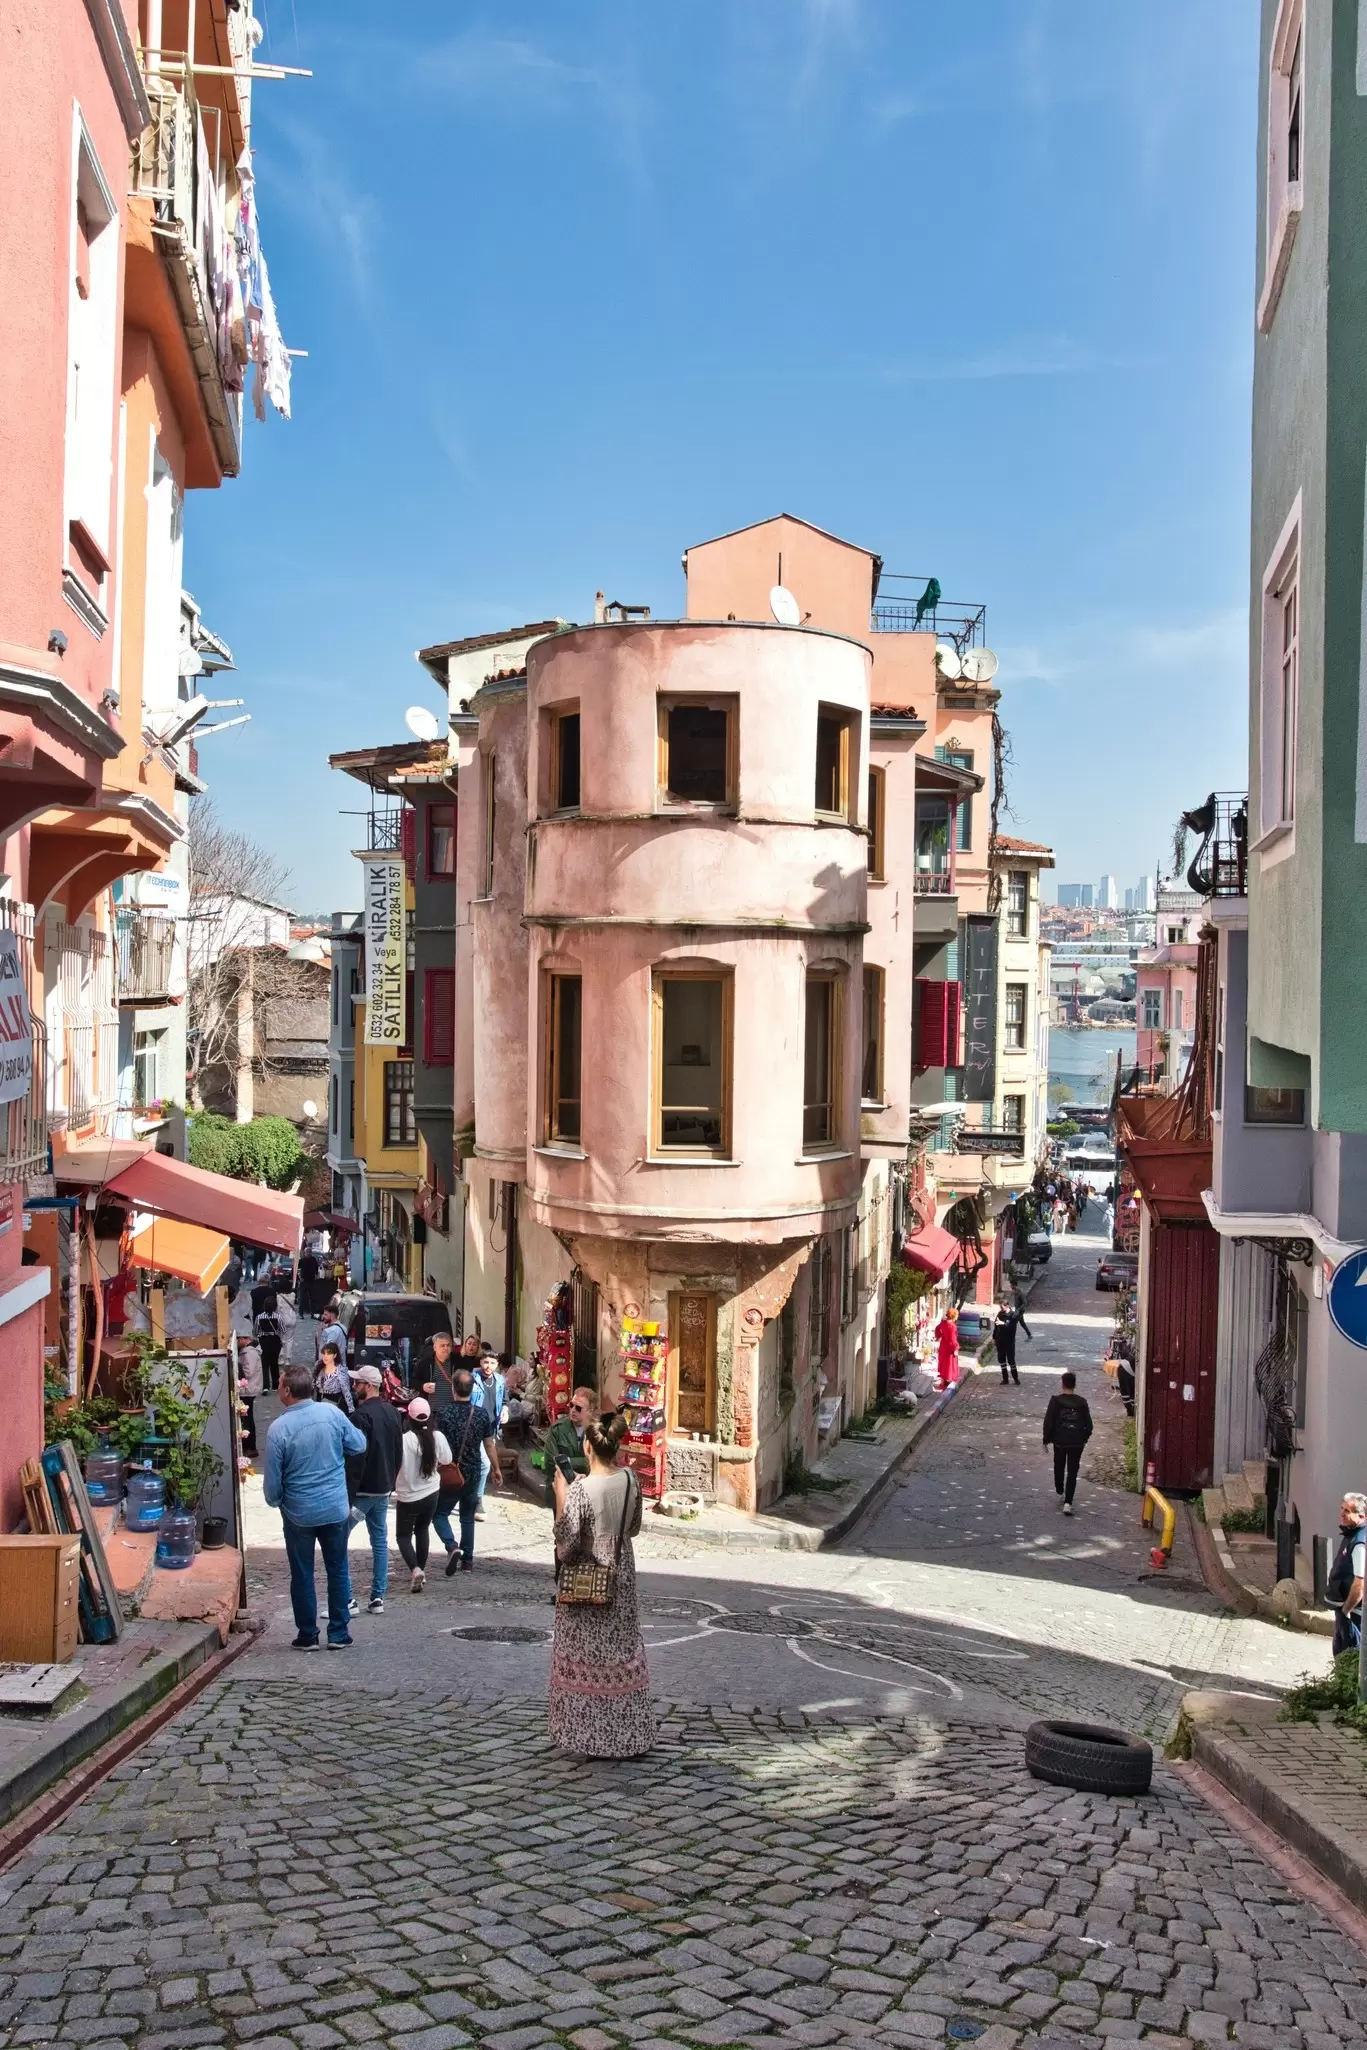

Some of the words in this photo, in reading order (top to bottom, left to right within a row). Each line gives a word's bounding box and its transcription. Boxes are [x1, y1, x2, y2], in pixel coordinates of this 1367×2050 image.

[388, 866, 401, 878] 57
[389, 881, 401, 894] 78
[368, 867, 387, 943] KİRALIK
[389, 897, 401, 916] 284
[374, 947, 397, 959] Veya
[371, 963, 383, 975] 34
[372, 978, 383, 990] 32
[372, 993, 384, 1011] 602
[383, 963, 401, 1039] SATILIK
[370, 1014, 383, 1038] 0532
